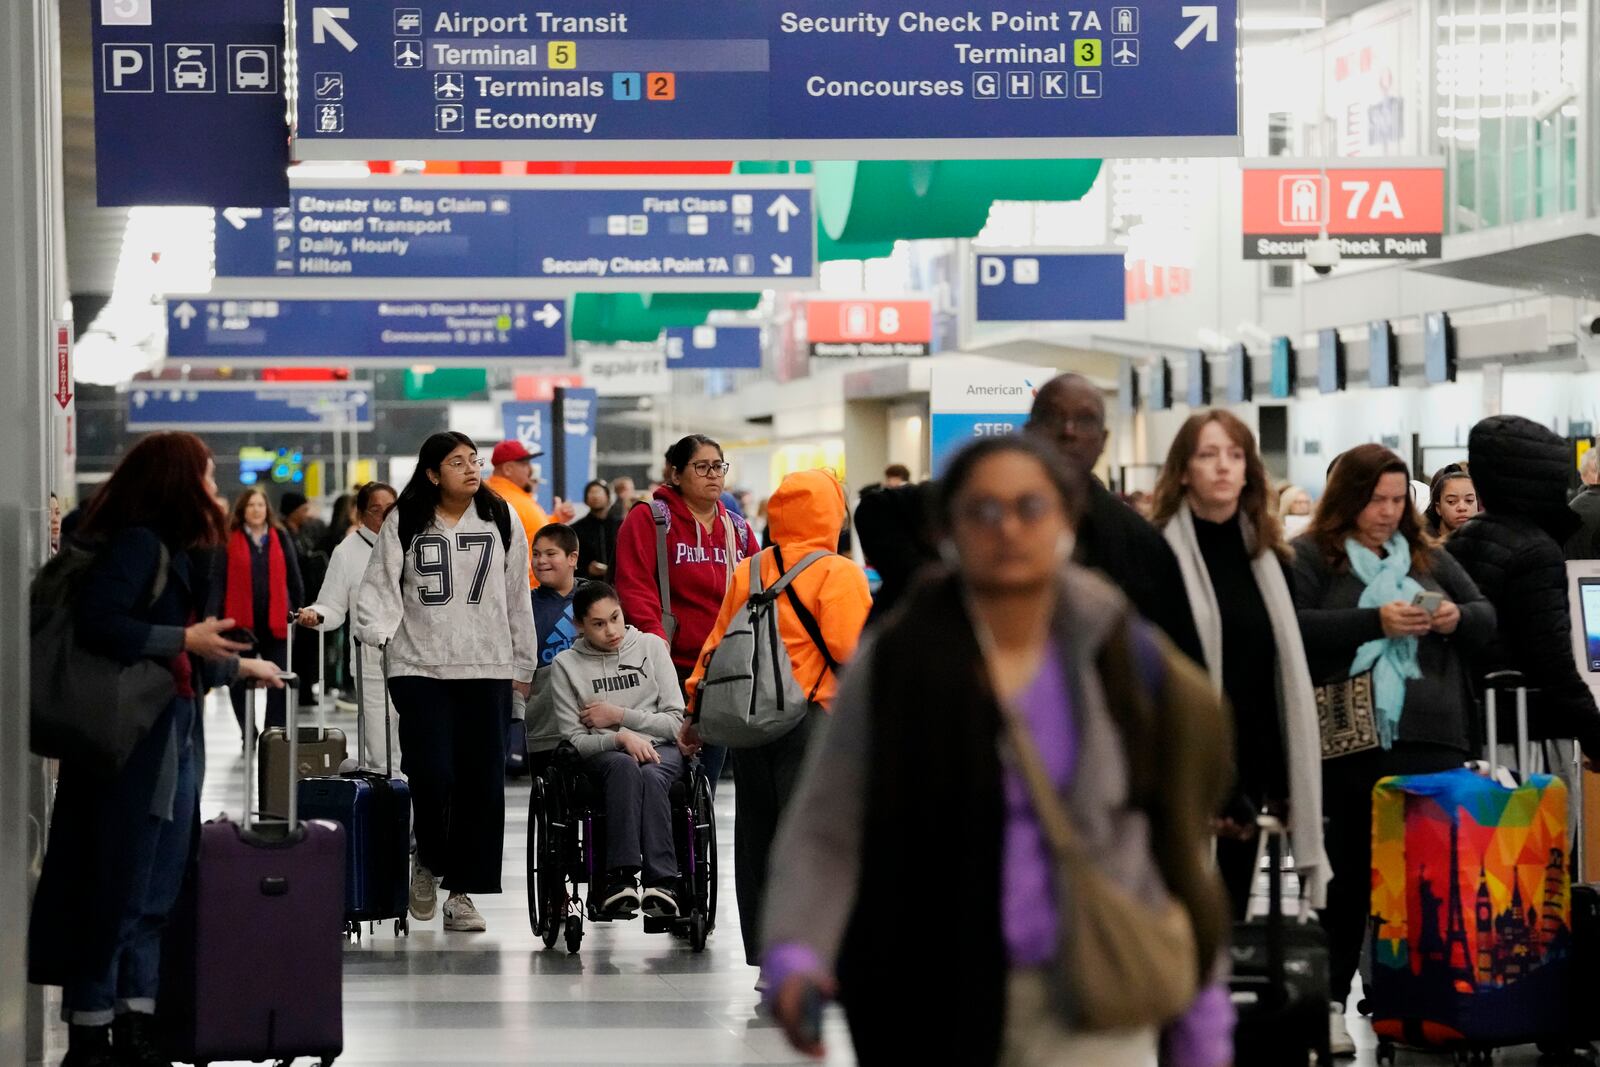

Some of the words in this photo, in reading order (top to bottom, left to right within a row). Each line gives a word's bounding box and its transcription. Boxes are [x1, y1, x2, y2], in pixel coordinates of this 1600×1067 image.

[434, 12, 528, 36] Airport
[536, 12, 628, 32] Transit
[780, 12, 890, 36] Security
[899, 12, 982, 32] Check
[991, 12, 1060, 32] Point
[1068, 12, 1102, 32] 7A
[433, 44, 537, 66] Terminal
[556, 46, 569, 64] 5
[954, 44, 1066, 64] Terminal
[1080, 44, 1095, 62] 3
[112, 50, 143, 87] P
[474, 76, 604, 98] Terminals
[654, 78, 668, 96] 2
[806, 76, 964, 98] Concourses
[976, 76, 996, 96] G
[1012, 76, 1030, 95] H
[1045, 76, 1064, 95] K
[1081, 76, 1096, 95] L
[441, 108, 458, 128] P
[474, 108, 598, 134] Economy
[299, 196, 368, 213] Elevator
[373, 196, 396, 212] to:
[400, 196, 434, 216] Bag
[437, 196, 486, 213] Claim
[642, 196, 680, 213] First
[682, 196, 728, 213] Class
[1341, 181, 1405, 219] 7A
[299, 216, 364, 233] Ground
[367, 216, 451, 235] Transport
[299, 238, 348, 255] Daily,
[351, 238, 409, 256] Hourly
[1258, 238, 1321, 255] Securi
[1385, 238, 1428, 254] Point
[300, 257, 352, 273] Hilton
[542, 257, 608, 276] Security
[610, 256, 661, 273] Check
[663, 256, 706, 273] Point
[708, 256, 729, 273] 7A
[981, 258, 1005, 285] D
[879, 306, 900, 335] 8
[966, 384, 1023, 396] American
[411, 532, 496, 606] 97
[592, 673, 641, 694] PUMA
